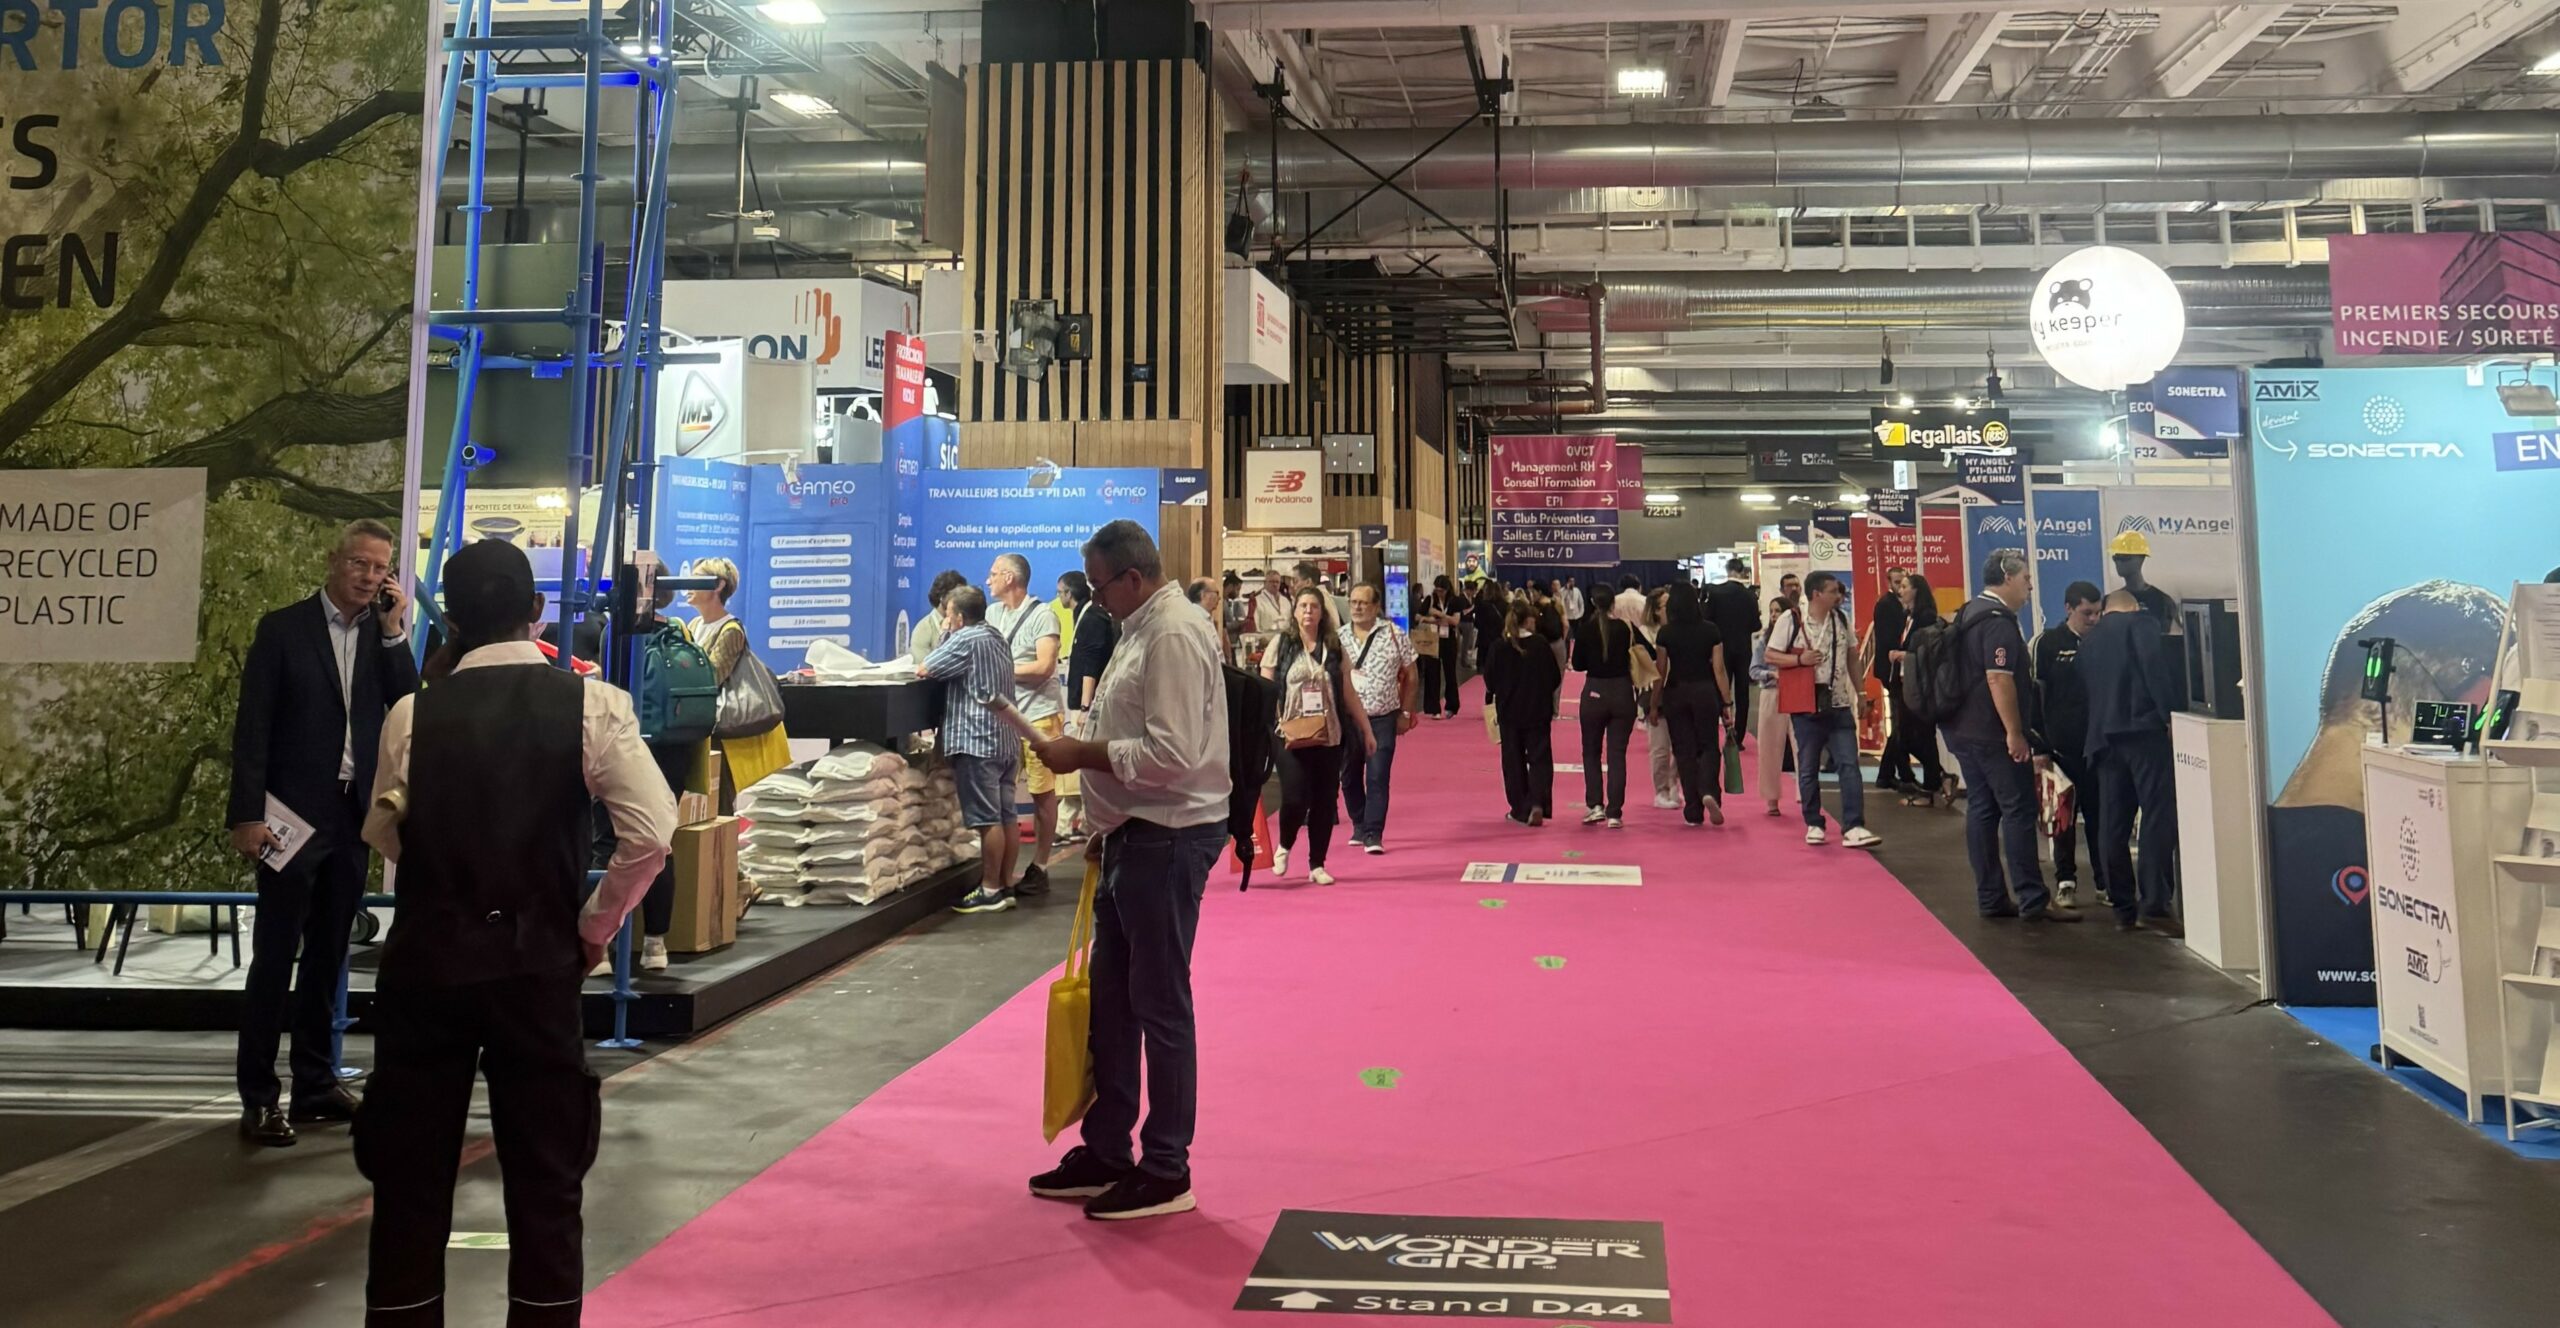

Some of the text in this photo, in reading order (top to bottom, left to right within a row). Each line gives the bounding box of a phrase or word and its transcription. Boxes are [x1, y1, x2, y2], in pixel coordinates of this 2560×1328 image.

[0, 114, 60, 190] S
[2341, 304, 2559, 321] PREMIERS SECOURS
[2343, 330, 2449, 346] INCENDIE
[2472, 326, 2555, 346] SÛRETÉ
[2168, 387, 2226, 397] SONECTRA
[681, 399, 716, 424] IMS
[1905, 424, 1981, 448] legallais
[2160, 426, 2179, 435] F30
[1566, 446, 1595, 456] QVCT
[2135, 448, 2157, 458] F32
[2308, 443, 2464, 458] SONECTRA
[1511, 461, 1595, 475] Management RH
[789, 481, 856, 495] GAMEO
[1503, 477, 1538, 487] Conseil
[1545, 478, 1595, 487] Formation
[928, 487, 999, 498] TRAVAILLEURS
[1104, 486, 1147, 497] GAMEO
[1255, 495, 1313, 504] new balance
[1546, 496, 1563, 506] EPI
[0, 502, 151, 532] MADE OF
[1514, 513, 1595, 524] Club Préventica
[946, 524, 981, 534] Oubliez
[985, 524, 998, 534] les
[1001, 523, 1061, 536] applications
[2018, 517, 2092, 533] MyAngel
[2159, 517, 2234, 532] MyAngel
[1503, 530, 1533, 541] Salles
[1536, 531, 1542, 540] E
[1554, 529, 1597, 541] Plénière
[934, 539, 975, 549] Scannez
[978, 539, 1034, 550] simplement
[1036, 540, 1059, 550] pour
[1515, 548, 1545, 558] Salles
[1548, 548, 1554, 558] C
[1566, 548, 1573, 558] D
[2036, 549, 2069, 560] DATI
[0, 548, 157, 578] RECYCLED
[0, 595, 125, 625] PLASTIC
[2378, 885, 2452, 934] SONECTRA
[1313, 1231, 1646, 1258] WONDER
[1388, 1253, 1558, 1269] GRIP
[1353, 1296, 1643, 1317] Stand D44
